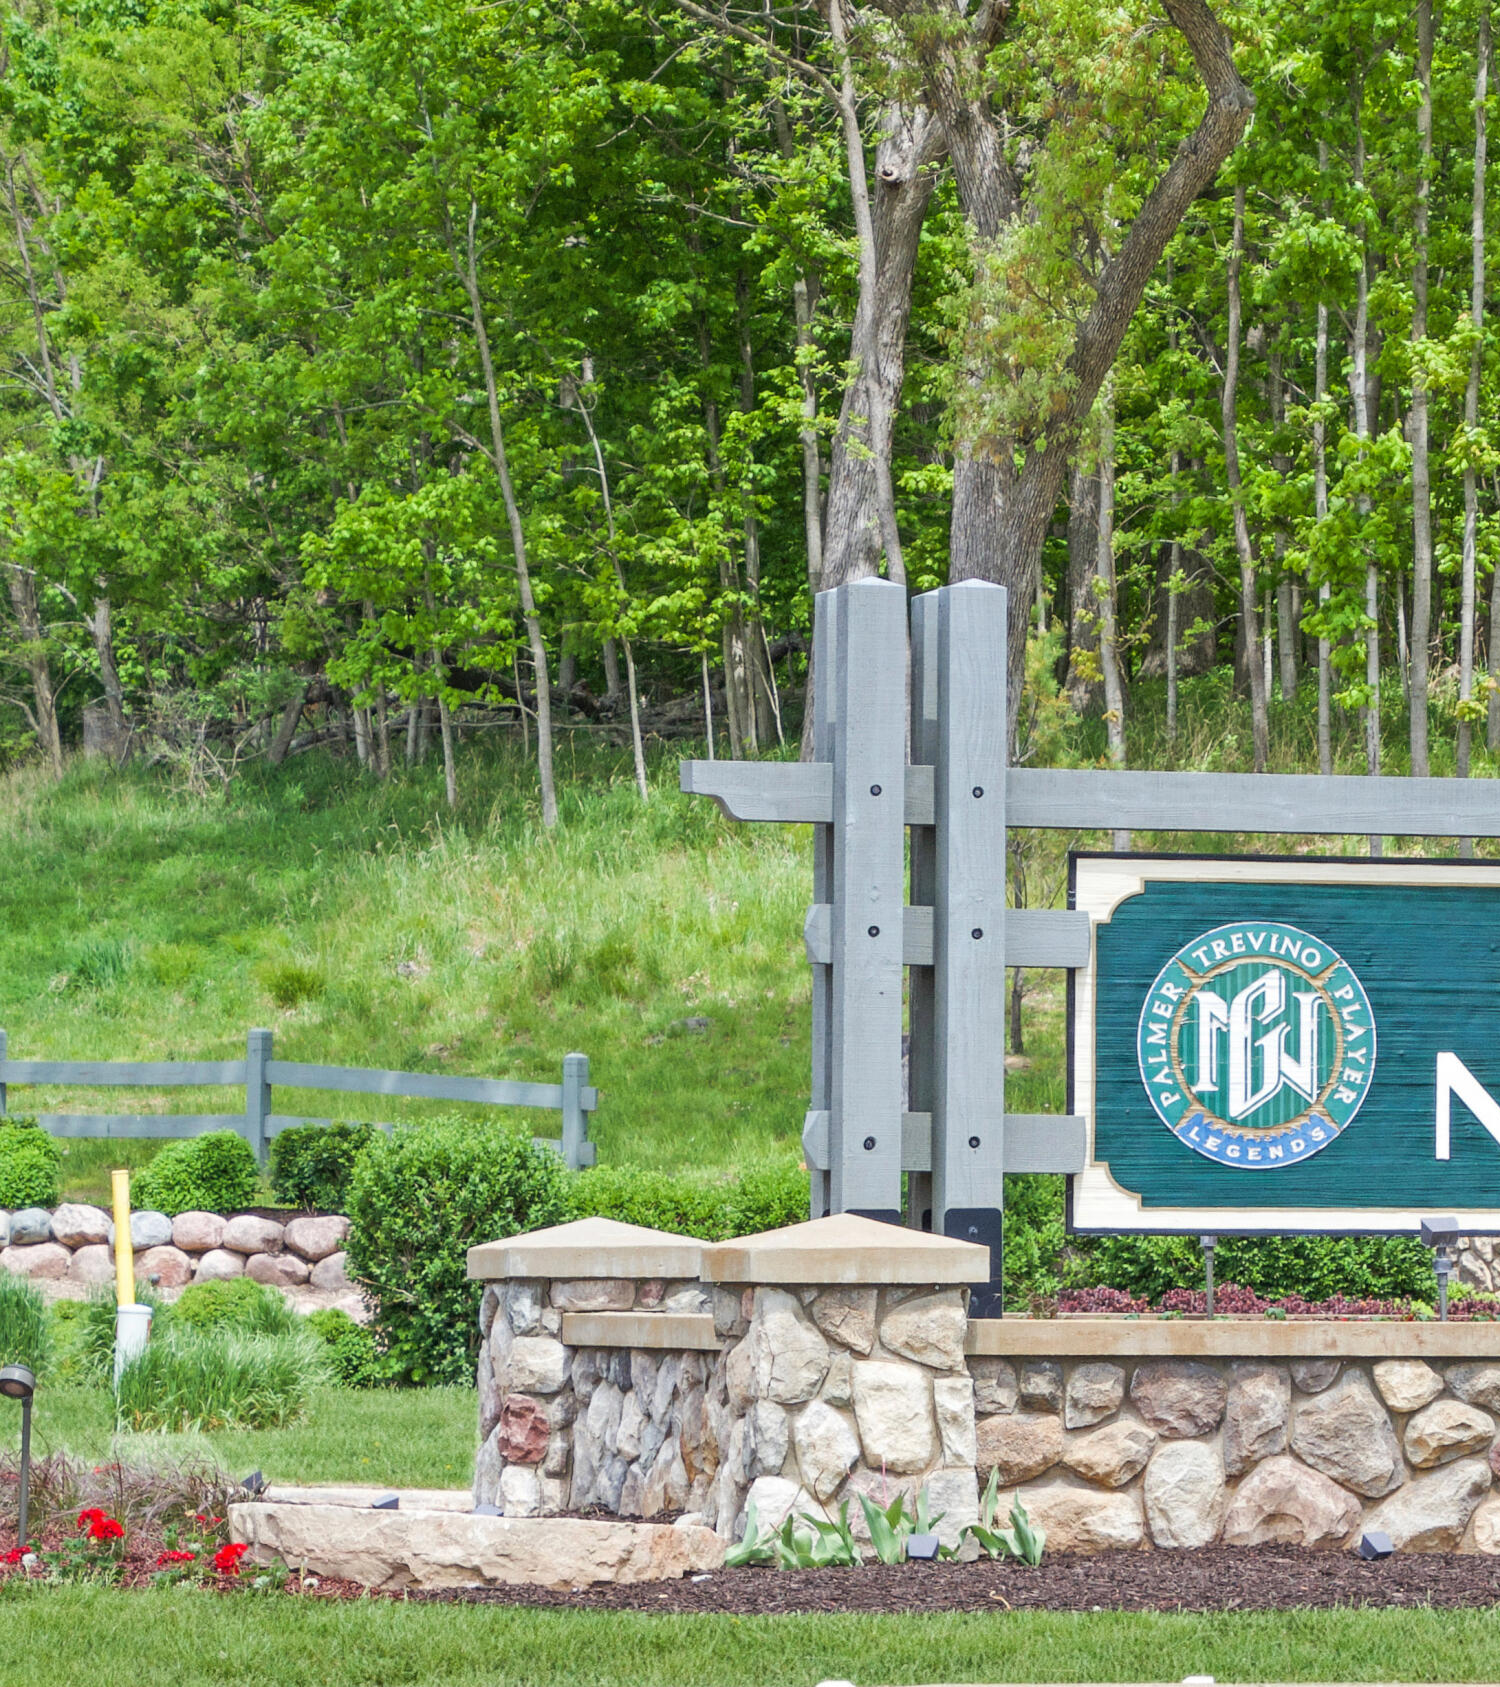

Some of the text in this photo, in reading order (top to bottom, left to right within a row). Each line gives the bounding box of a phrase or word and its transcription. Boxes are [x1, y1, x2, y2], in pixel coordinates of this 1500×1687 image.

[1191, 931, 1322, 969] TREVINO
[1146, 980, 1184, 1108] PALMER
[1333, 983, 1368, 1105] PLAYER
[1187, 1126, 1328, 1161] LEGENDS
